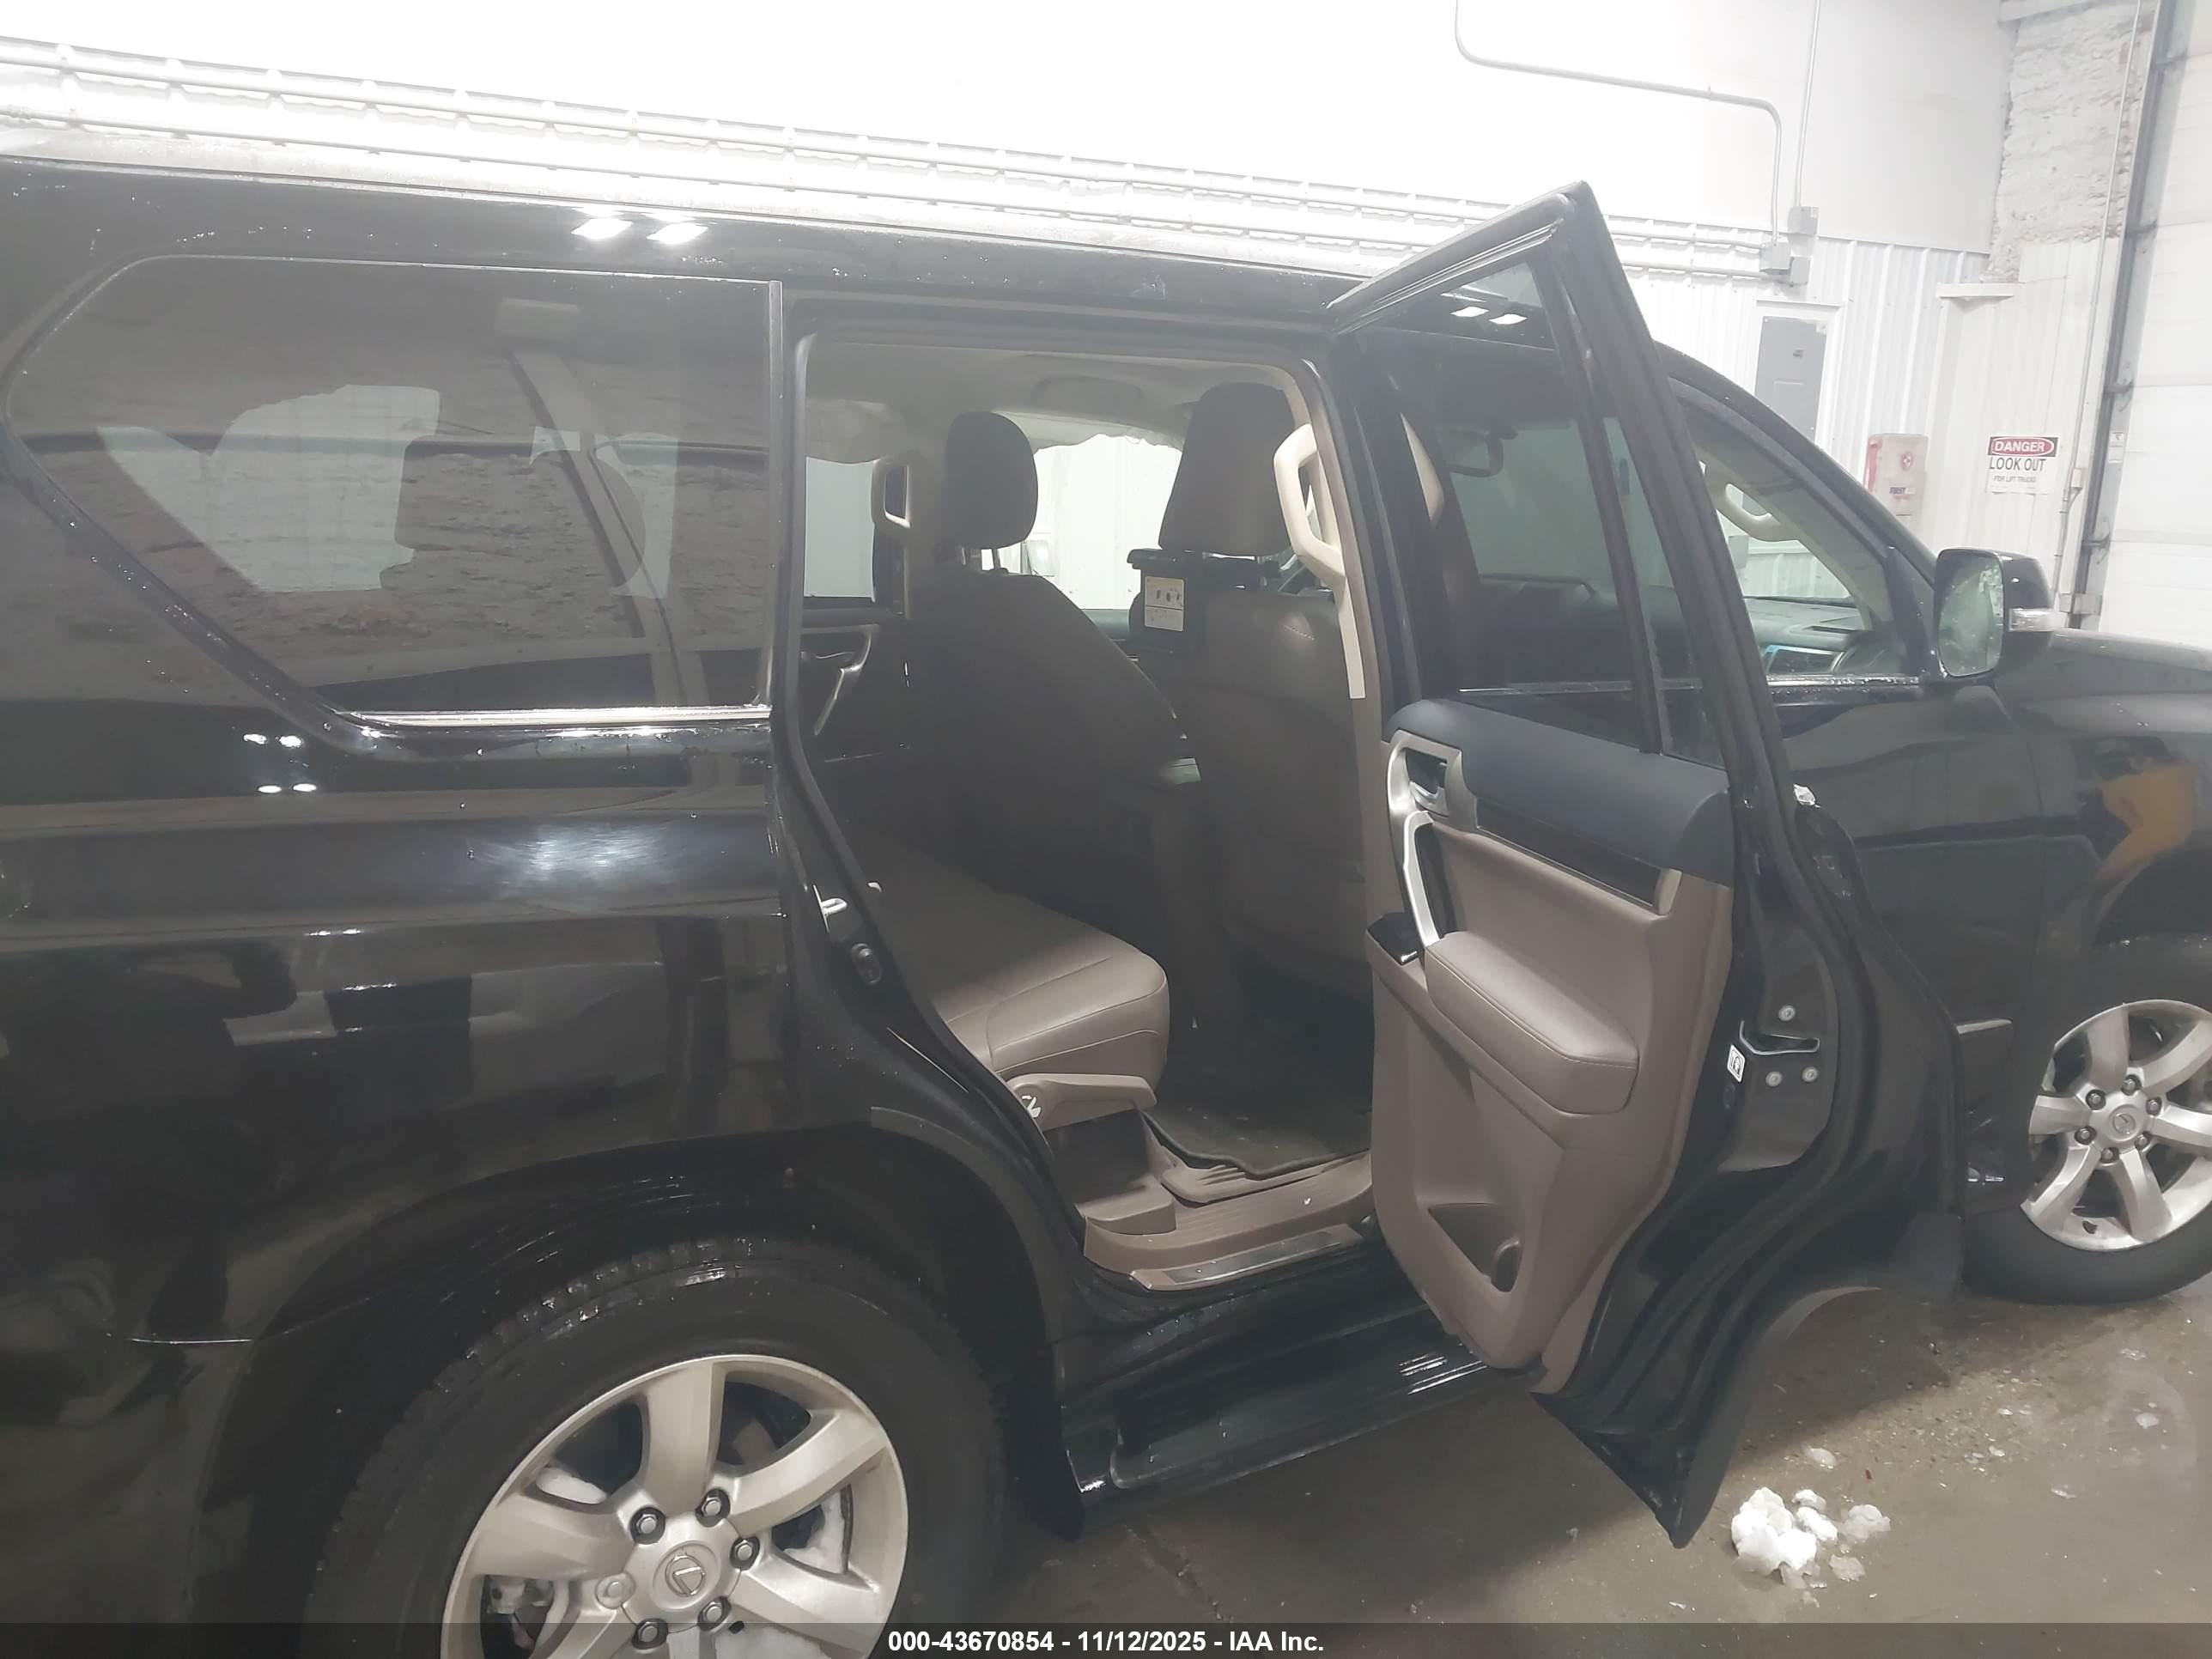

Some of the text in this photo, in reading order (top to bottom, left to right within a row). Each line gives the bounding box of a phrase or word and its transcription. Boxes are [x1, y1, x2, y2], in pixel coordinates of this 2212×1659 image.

[1994, 441, 2045, 452] DANGER
[1989, 457, 2046, 471] LOOK OUT
